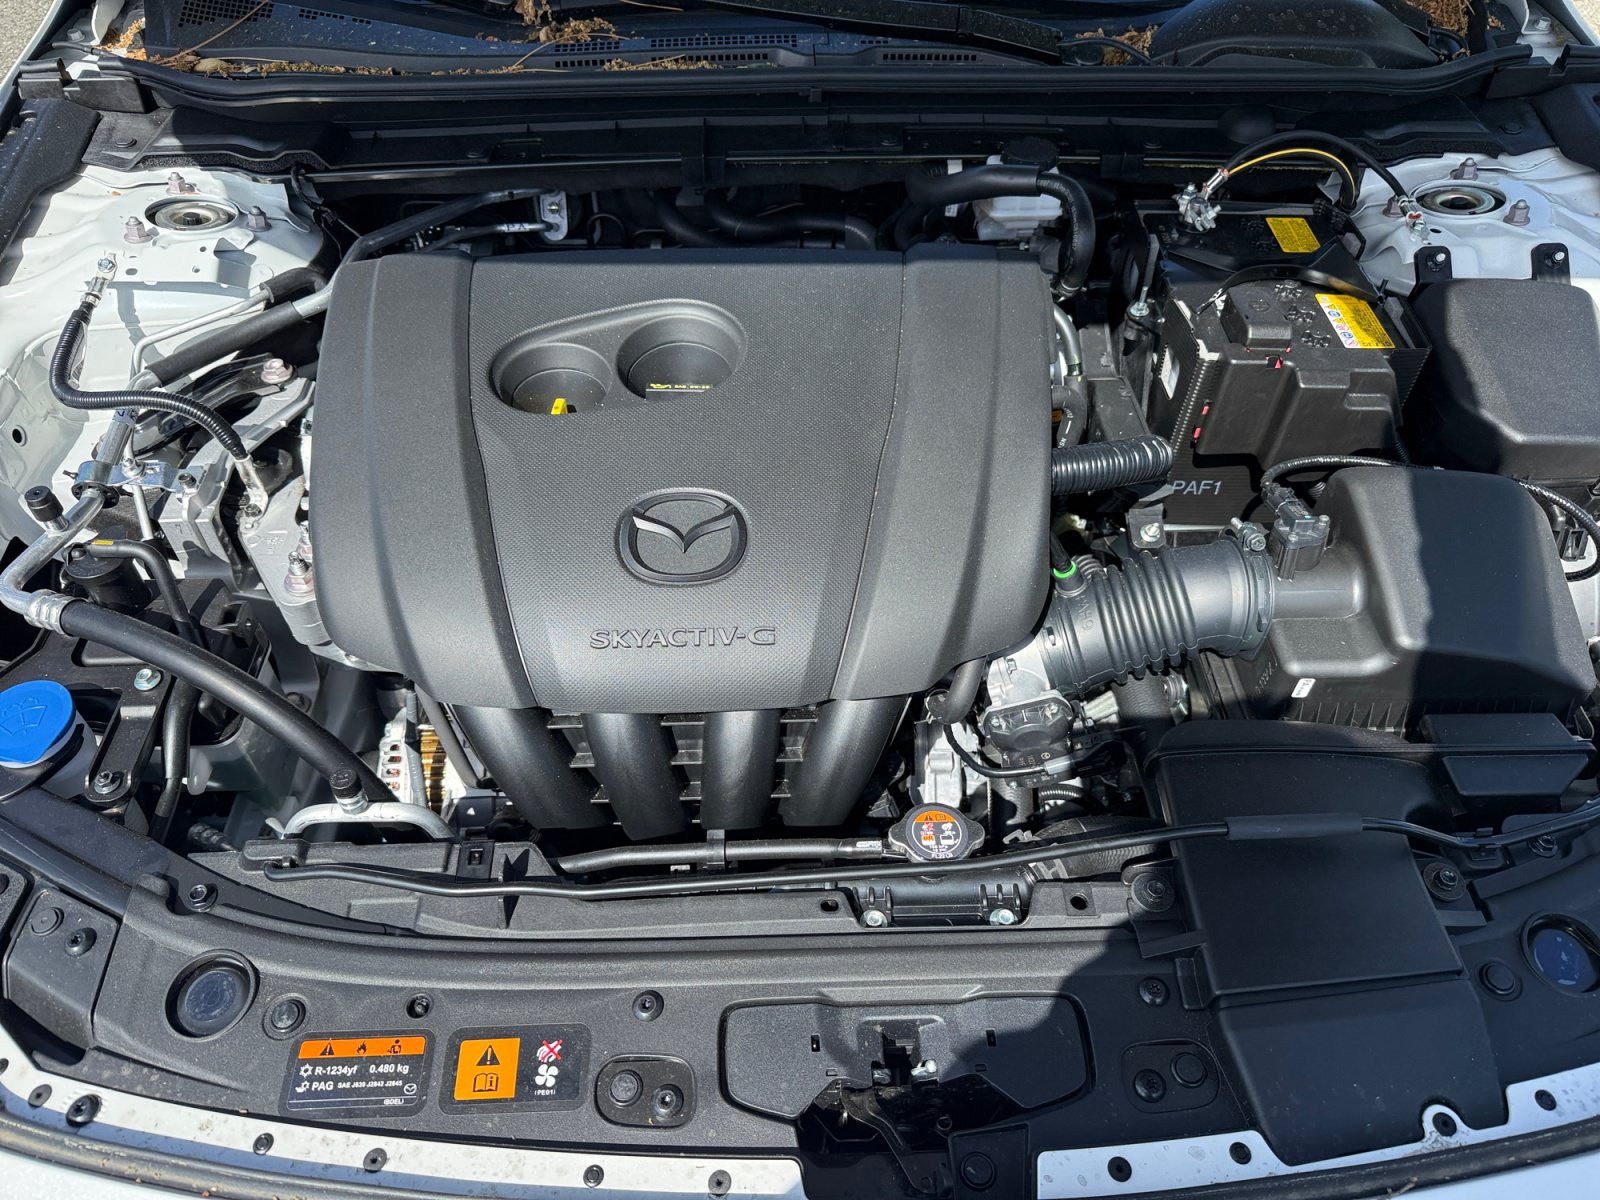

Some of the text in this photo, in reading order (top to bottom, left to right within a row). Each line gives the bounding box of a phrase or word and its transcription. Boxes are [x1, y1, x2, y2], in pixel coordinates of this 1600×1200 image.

[1171, 480, 1222, 495] PAF1
[590, 627, 776, 650] SKYACTIV-G
[314, 1063, 410, 1077] R-1234yf 0.480 kg
[311, 1081, 334, 1091] PAG
[337, 1081, 351, 1089] SAE
